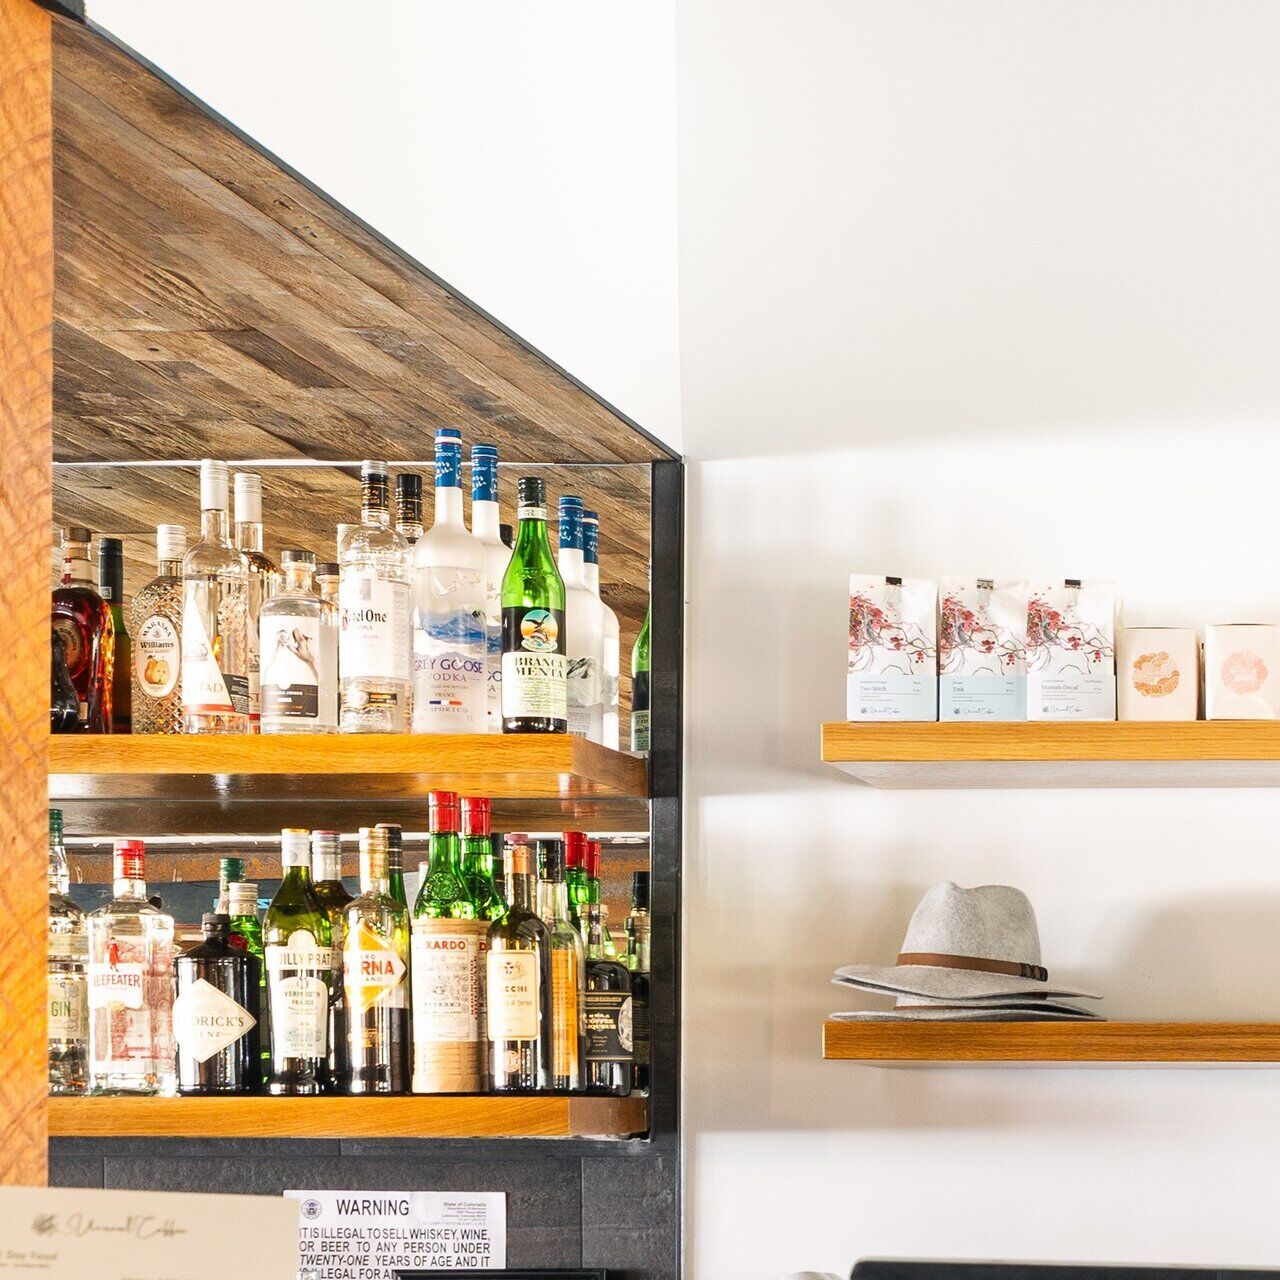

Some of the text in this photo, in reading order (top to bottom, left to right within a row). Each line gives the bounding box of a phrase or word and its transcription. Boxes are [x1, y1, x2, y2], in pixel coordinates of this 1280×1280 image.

[365, 609, 387, 623] One
[140, 640, 175, 649] Williams
[440, 658, 483, 674] GOOSE
[515, 657, 563, 670] BRANCA
[515, 666, 563, 679] MENTA
[51, 1001, 71, 1017] GIN
[192, 1016, 245, 1027] DRICK'S
[336, 1199, 410, 1216] WARNING
[299, 1227, 491, 1242] IT IS ILLEGAL TO SELL WHISKEY, WINE,
[299, 1241, 491, 1254] OR BEER TO ANY PERSON UNDER
[300, 1254, 491, 1267] TWENTY-ONE YEARS OF AGE AND IT
[359, 1268, 381, 1279] FOR
